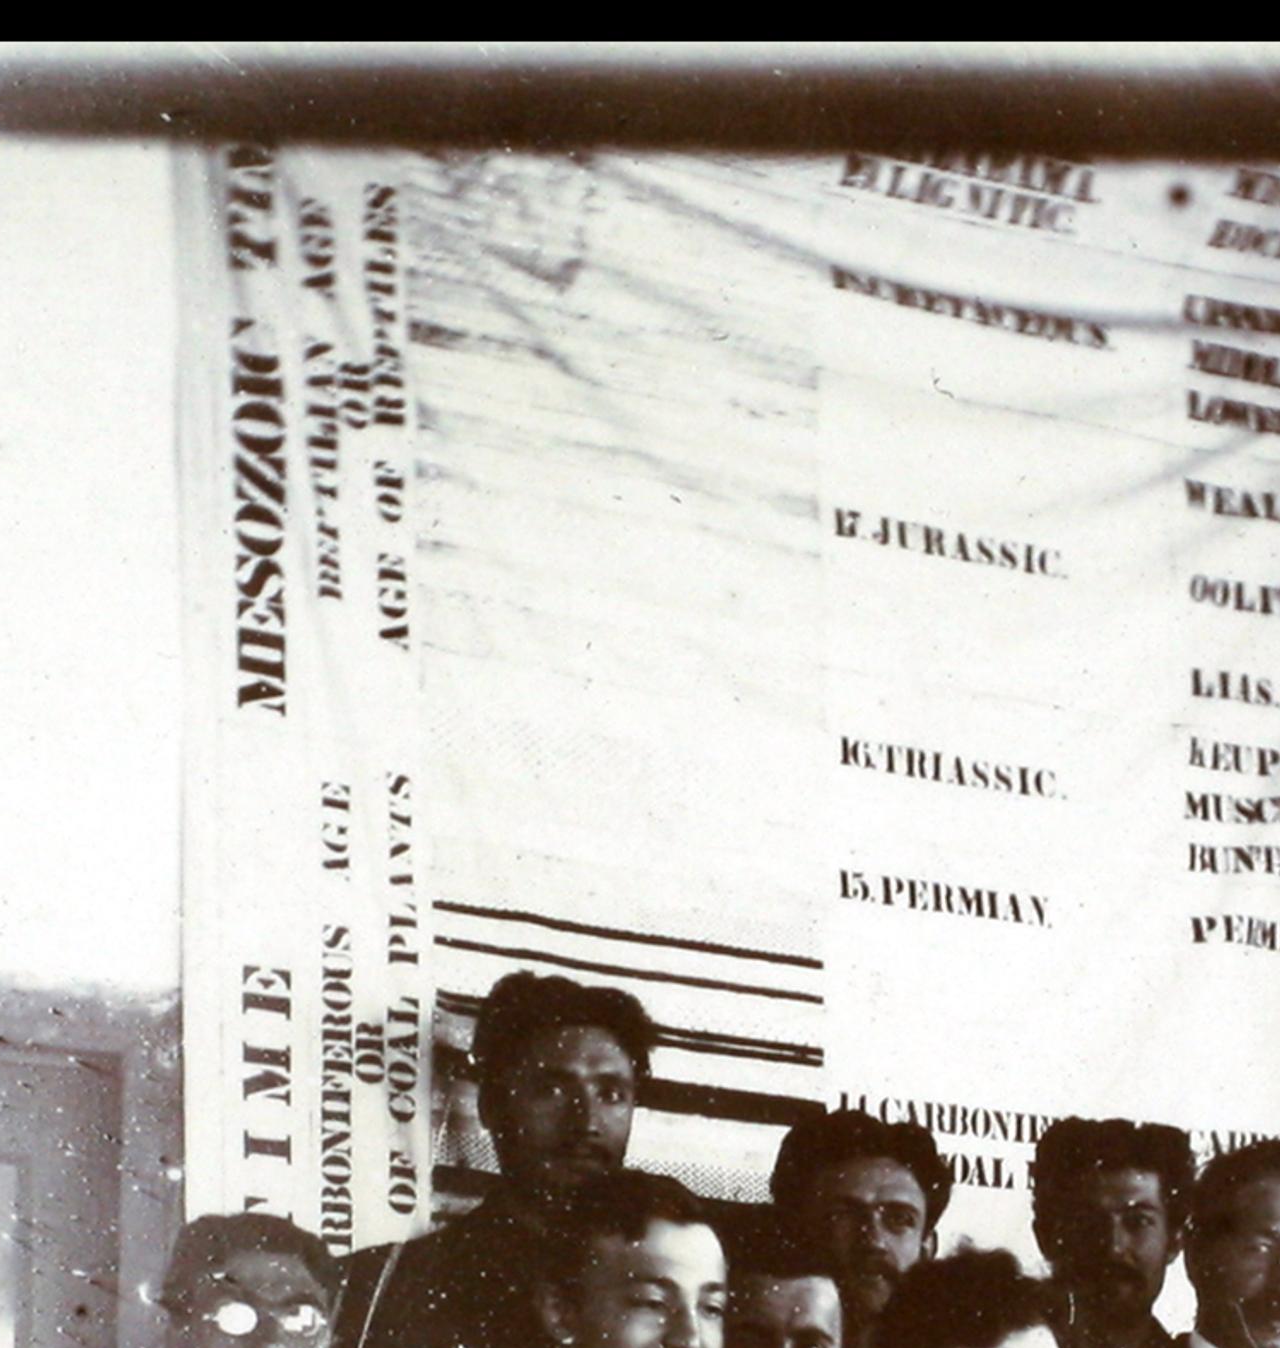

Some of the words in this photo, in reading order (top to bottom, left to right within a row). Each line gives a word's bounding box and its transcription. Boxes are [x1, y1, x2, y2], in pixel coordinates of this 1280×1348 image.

[300, 197, 337, 299] AGE
[363, 182, 406, 426] REPTILES
[339, 361, 371, 429] OR
[231, 317, 287, 717] MESOZOIC
[303, 334, 343, 600] REPTILIAN
[373, 460, 404, 523] OF
[376, 552, 409, 652] AGE
[320, 781, 352, 881] AGE
[386, 771, 420, 966] PLANTS
[320, 924, 353, 1257] RBONIFEROUS
[355, 1021, 386, 1086] OR
[387, 996, 421, 1125] COAL
[388, 1149, 419, 1216] OF
